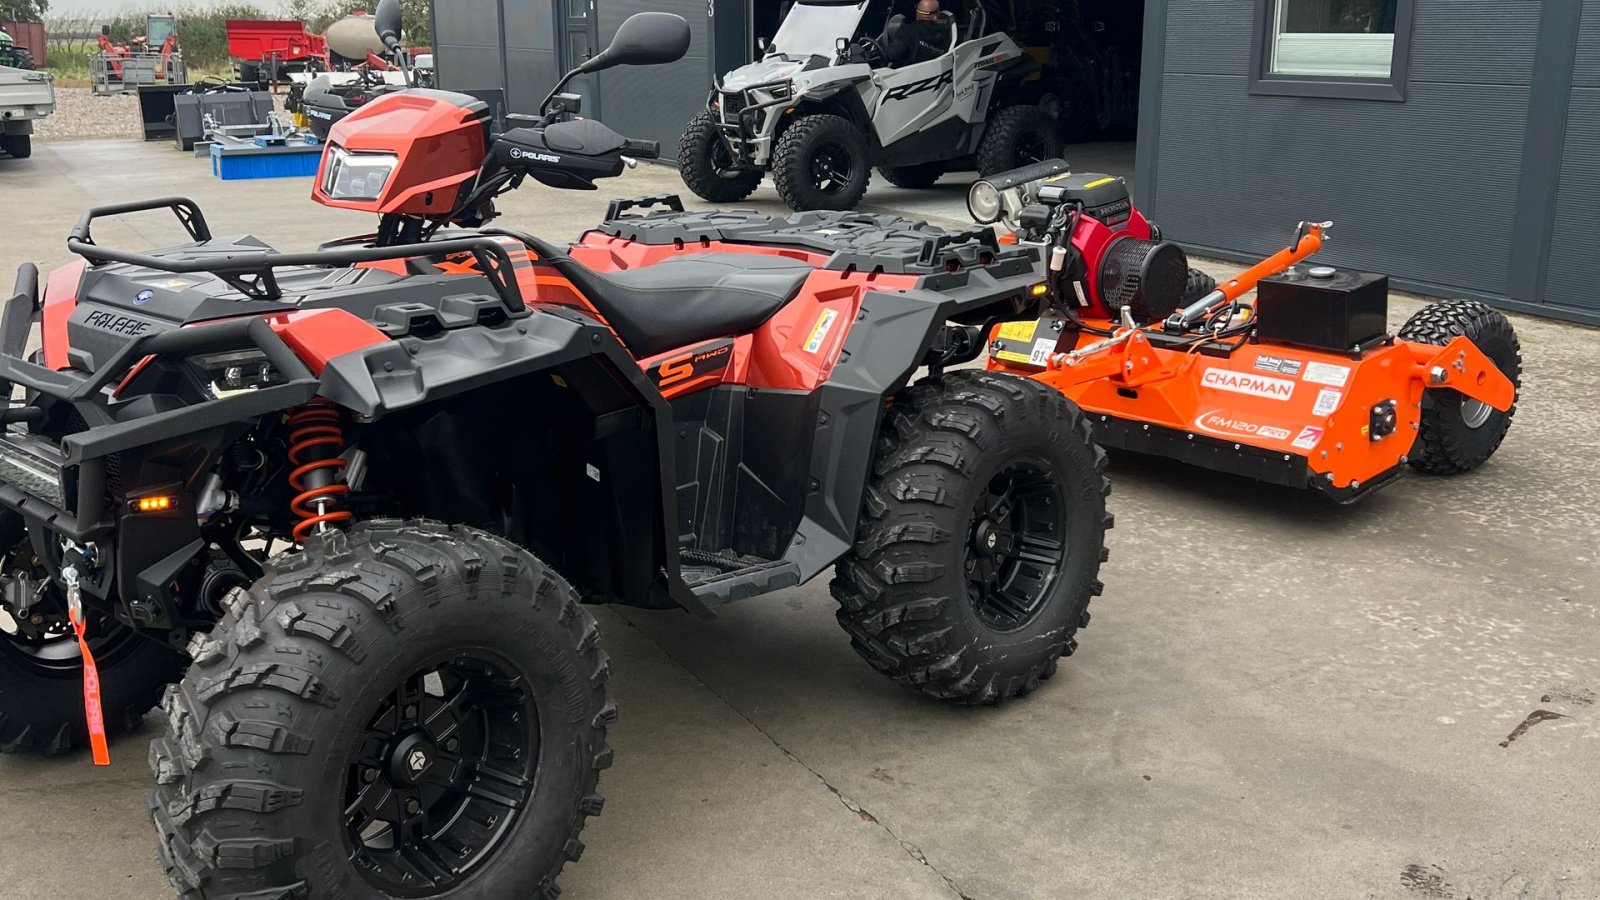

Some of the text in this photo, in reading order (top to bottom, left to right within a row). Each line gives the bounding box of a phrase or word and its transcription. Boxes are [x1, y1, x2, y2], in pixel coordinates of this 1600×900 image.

[881, 69, 953, 105] RZR
[522, 151, 560, 163] POLARIS
[1100, 202, 1129, 215] HONDA
[84, 310, 151, 335] POLARIS
[658, 347, 728, 387] S AWD
[1032, 350, 1049, 362] 91
[1204, 372, 1292, 396] CHAPMAN
[1207, 416, 1288, 438] FM120 PRO
[85, 664, 103, 734] POLARIS
